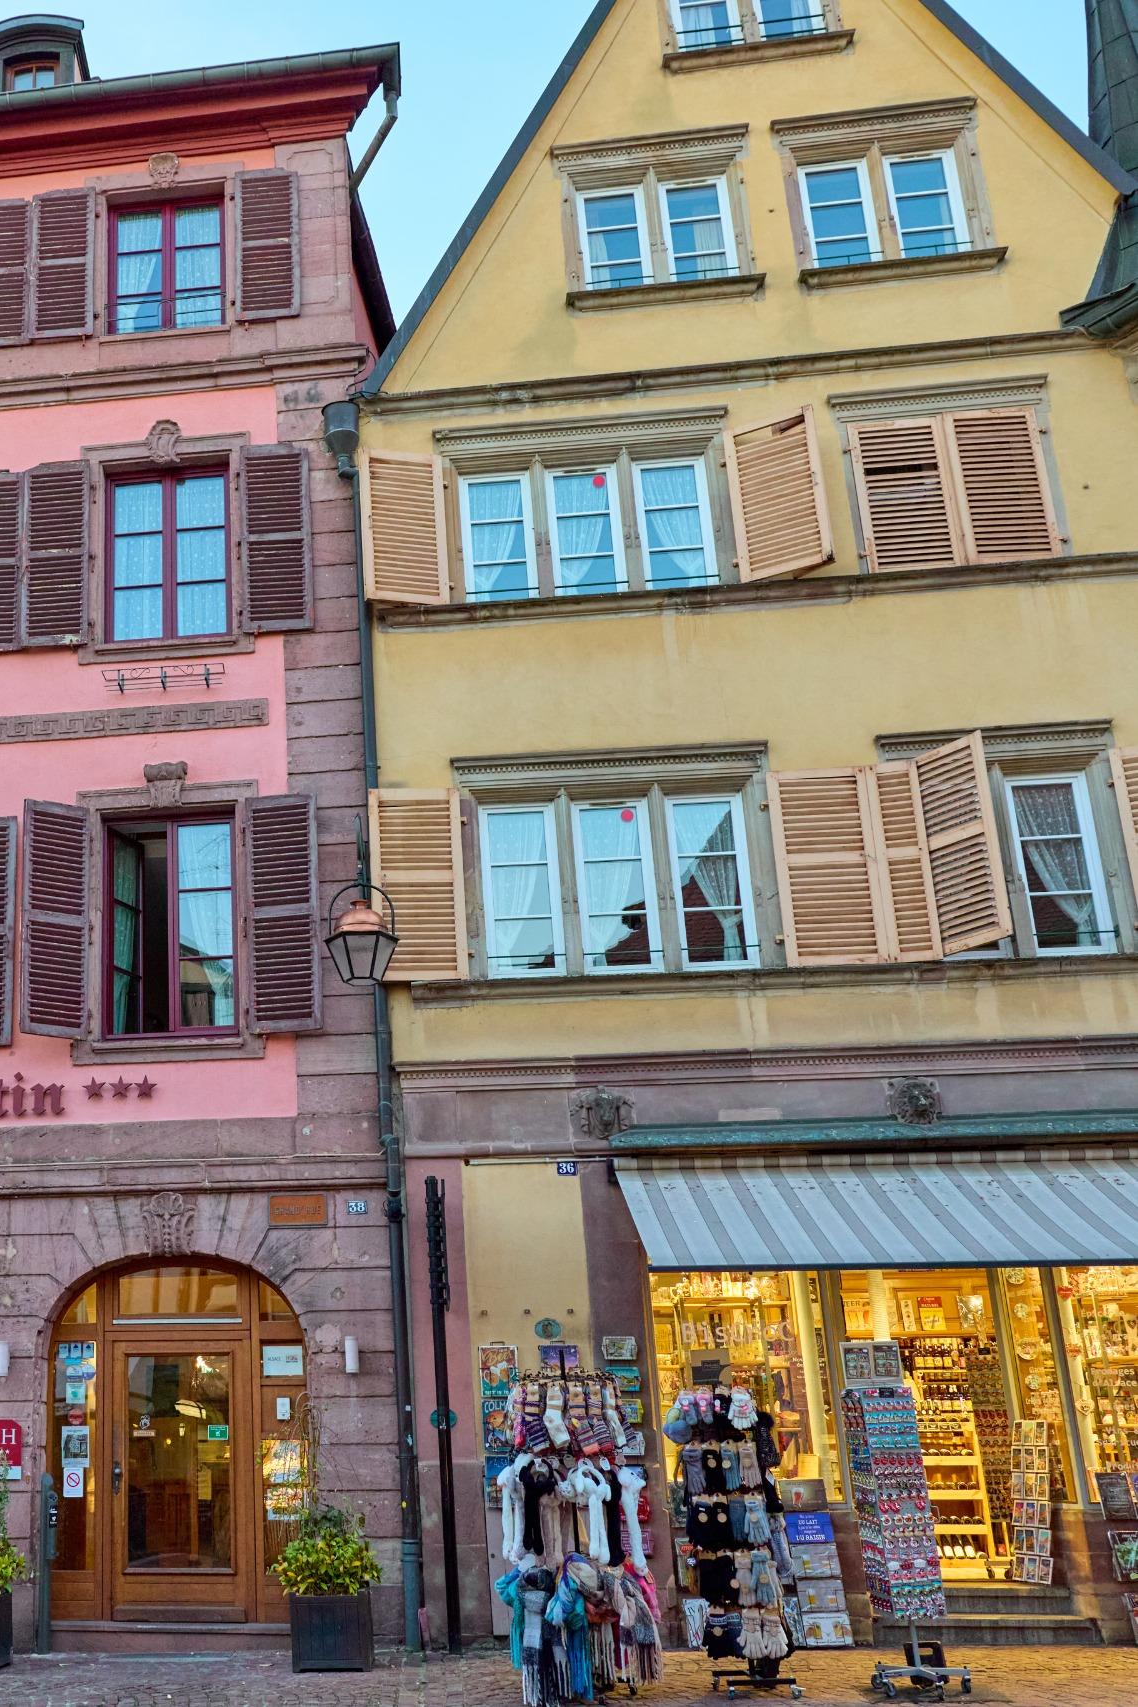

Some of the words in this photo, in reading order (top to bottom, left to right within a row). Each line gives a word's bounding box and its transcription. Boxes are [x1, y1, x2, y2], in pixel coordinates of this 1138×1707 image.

[559, 1162, 575, 1174] 36
[348, 1202, 365, 1212] 38
[484, 1401, 510, 1413] COLM
[1, 1429, 17, 1445] H
